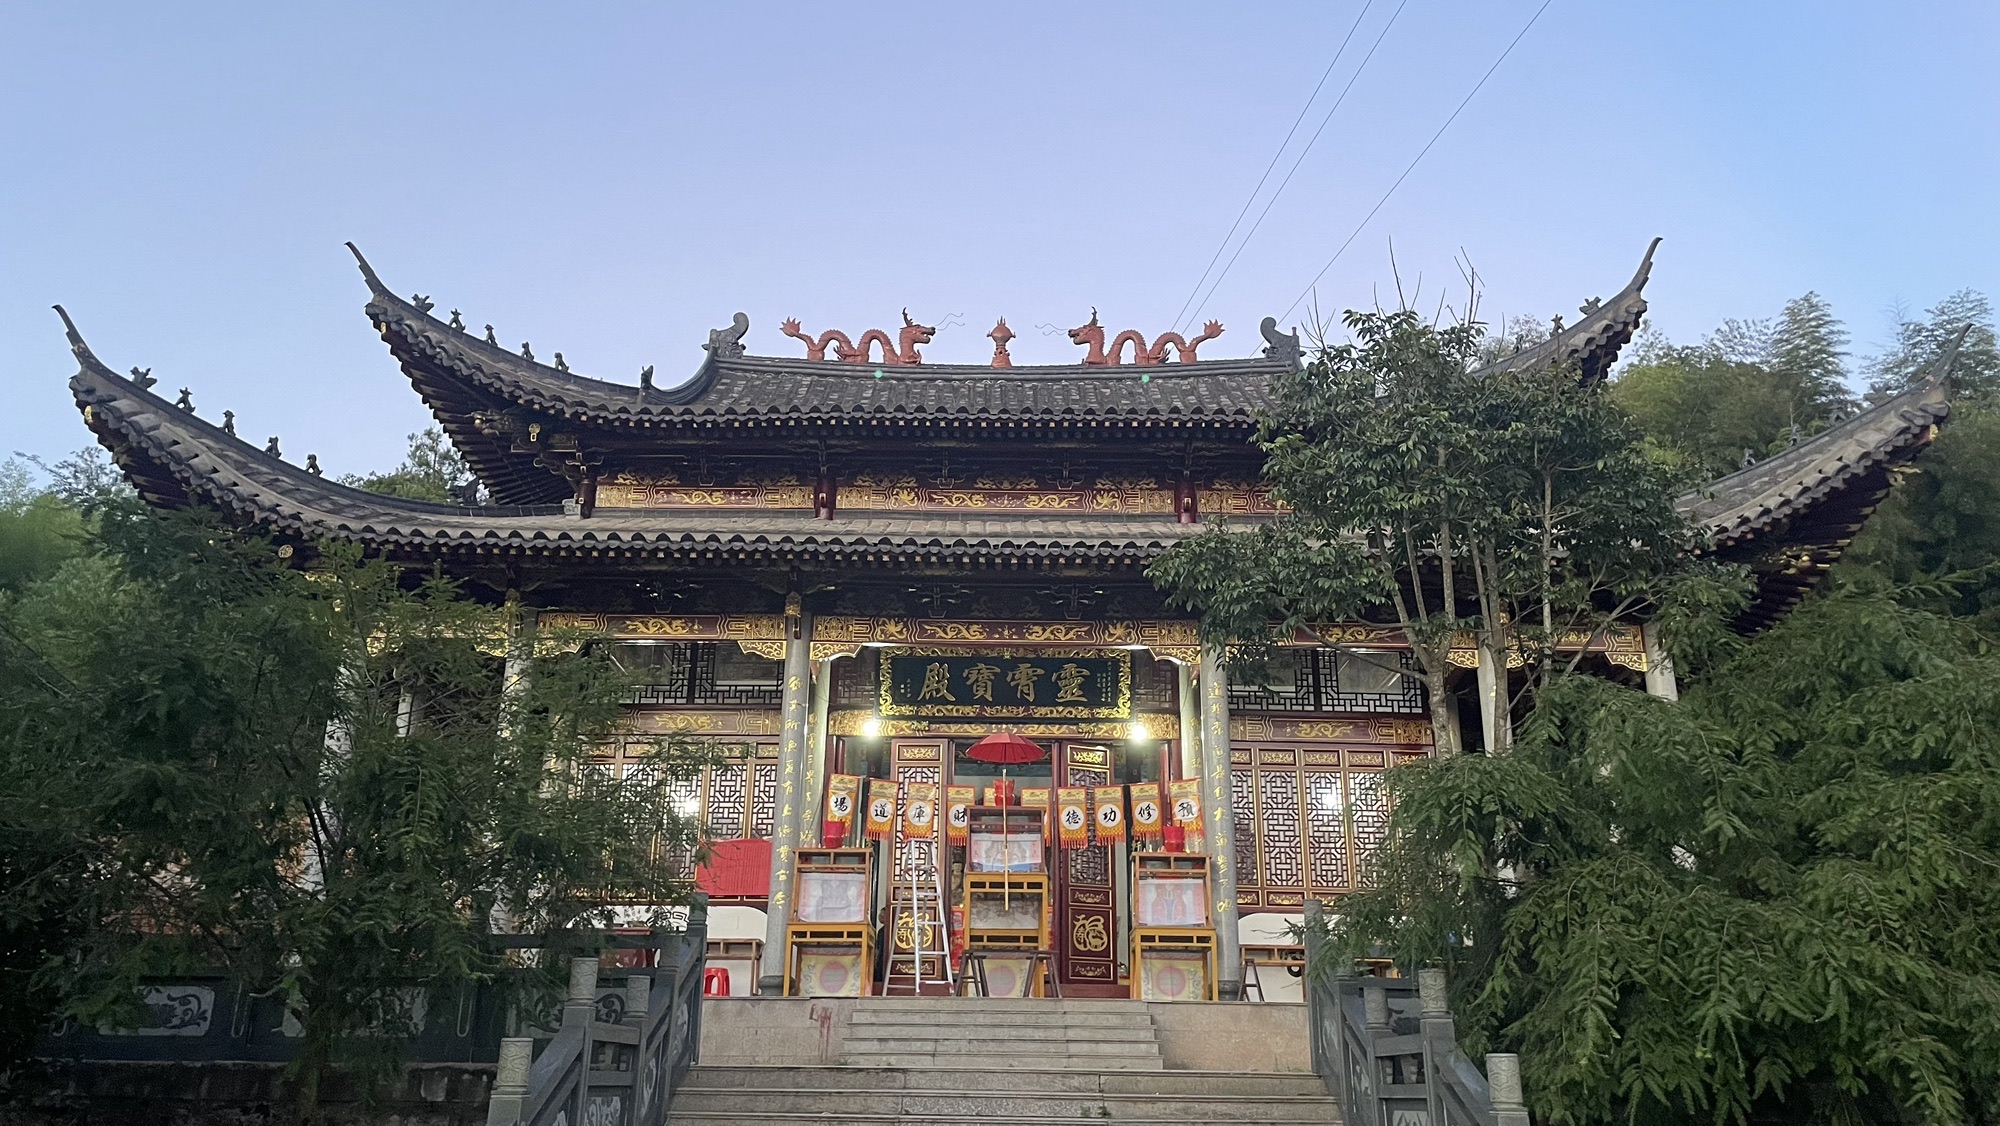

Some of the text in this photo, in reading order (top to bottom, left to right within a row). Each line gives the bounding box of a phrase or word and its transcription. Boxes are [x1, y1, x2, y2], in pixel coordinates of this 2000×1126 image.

[917, 662, 1091, 702] 靈霄寶殿
[834, 796, 848, 812] 場
[874, 803, 889, 818] 道
[1175, 801, 1195, 818] 預
[912, 805, 925, 821] 庫
[953, 808, 966, 823] 財
[1065, 809, 1081, 825] 德
[1103, 807, 1117, 823] 功
[1137, 804, 1156, 821] 修
